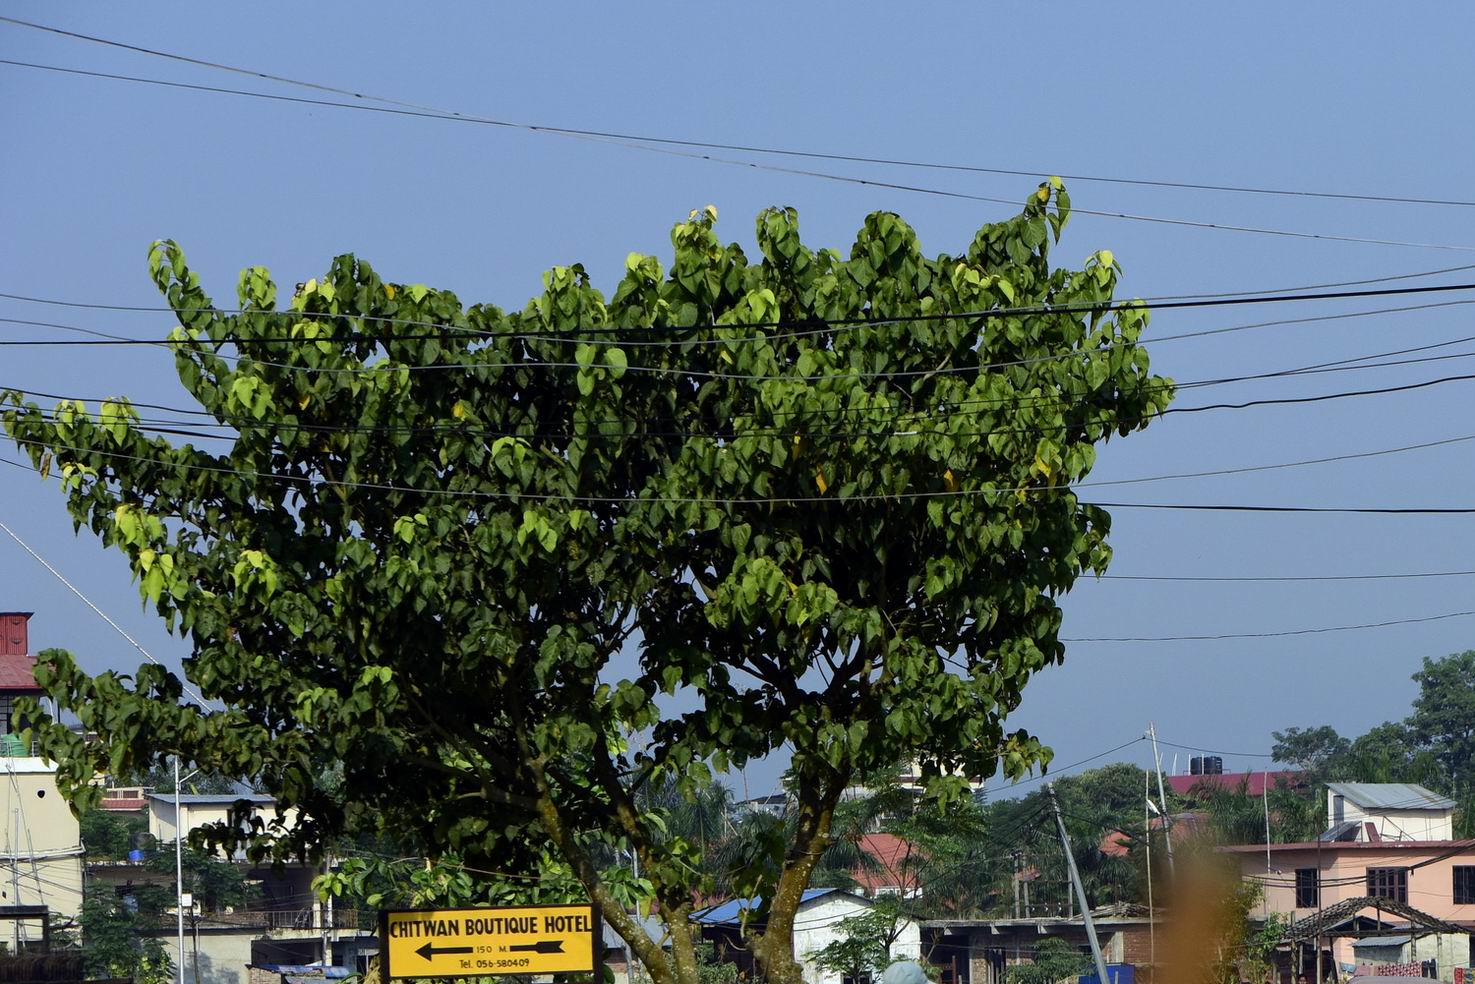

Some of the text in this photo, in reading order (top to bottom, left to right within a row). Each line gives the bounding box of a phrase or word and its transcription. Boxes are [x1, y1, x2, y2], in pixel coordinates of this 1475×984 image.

[390, 916, 592, 938] CHITWAN BOUTIQUE HOTEL
[459, 959, 529, 968] Tel. 056-580409
